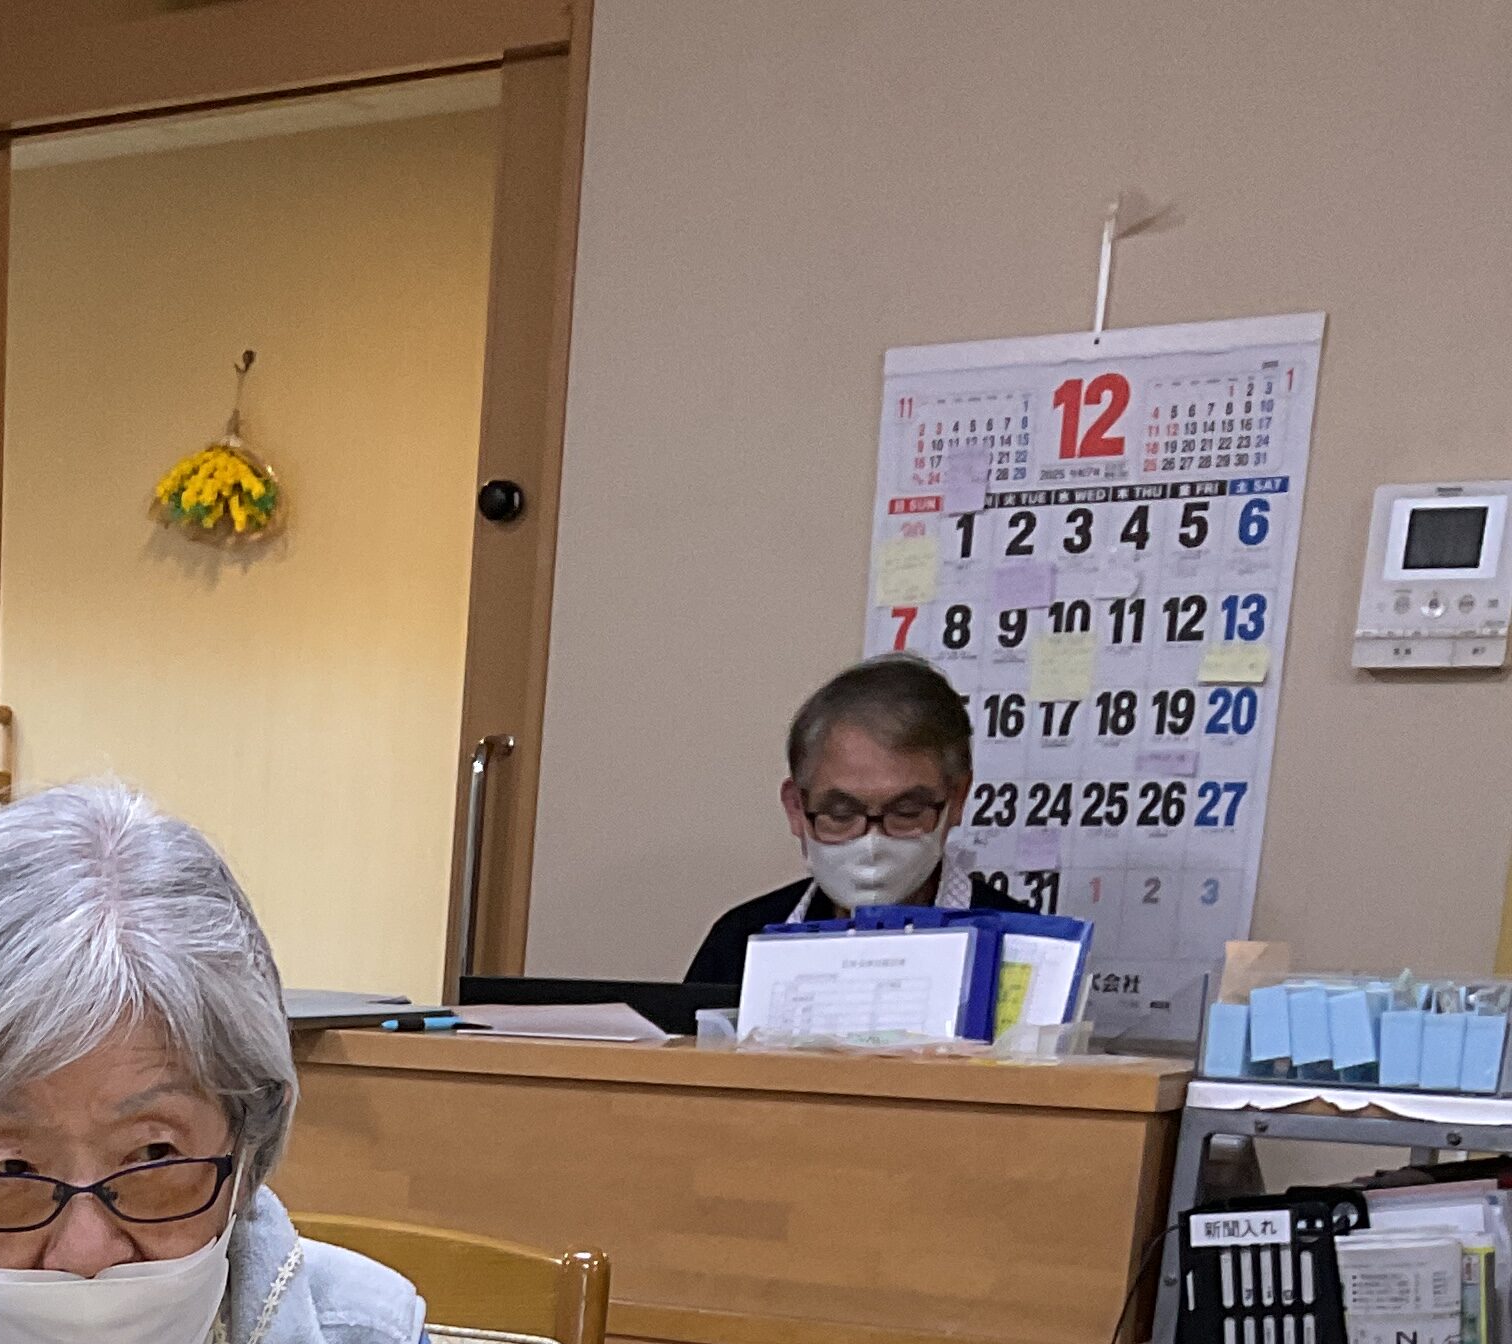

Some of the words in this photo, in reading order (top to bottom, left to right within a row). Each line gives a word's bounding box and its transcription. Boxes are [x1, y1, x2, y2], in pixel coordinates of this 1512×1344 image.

[1246, 383, 1254, 396] 2
[900, 398, 912, 418] 11
[1053, 373, 1130, 460] 12
[1152, 407, 1159, 419] 4
[1171, 405, 1177, 419] 5
[1189, 404, 1196, 417] 6
[1208, 403, 1215, 415] 7
[1226, 402, 1233, 415] 8
[1245, 401, 1252, 414] 9
[1261, 400, 1273, 412] 10
[953, 421, 959, 433] 4
[1004, 417, 1011, 430] 7
[1148, 425, 1159, 437] 11
[1167, 424, 1179, 436] 12
[1184, 422, 1197, 435] 13
[1203, 421, 1215, 433] 14
[1222, 420, 1234, 432] 15
[1240, 418, 1252, 431] 16
[1259, 417, 1272, 430] 17
[1145, 442, 1159, 454] 18
[1164, 441, 1177, 453] 19
[1182, 440, 1195, 452] 20
[1201, 439, 1213, 451] 21
[1218, 437, 1232, 450] 22
[1237, 436, 1251, 449] 23
[1255, 435, 1269, 448] 24
[1144, 459, 1157, 472] 25
[1161, 458, 1175, 470] 26
[1179, 457, 1193, 470] 27
[1198, 456, 1212, 469] 28
[1216, 455, 1230, 468] 29
[1234, 453, 1248, 466] 30
[1254, 452, 1266, 466] 31
[1075, 489, 1106, 502] WED
[1134, 485, 1163, 498] THU
[1196, 482, 1220, 495] FRI
[1253, 478, 1283, 492] SAT
[956, 513, 976, 558] 1
[1005, 511, 1037, 556] 2
[1063, 508, 1094, 554] 3
[1120, 505, 1149, 550] 4
[1178, 501, 1210, 549] 5
[1238, 498, 1270, 546] 6
[891, 606, 918, 652] 7
[942, 604, 972, 650] 8
[998, 608, 1028, 648] 9
[1048, 599, 1091, 632] 10
[1109, 598, 1146, 644] 11
[1162, 594, 1208, 642] 12
[1221, 593, 1268, 641] 13
[984, 693, 1026, 738] 16
[1039, 700, 1082, 737] 17
[1096, 690, 1137, 736] 18
[1152, 689, 1196, 735] 19
[1205, 687, 1258, 735] 20
[971, 782, 1019, 827] 23
[1025, 782, 1073, 827] 24
[1080, 781, 1130, 827] 25
[1136, 781, 1187, 827] 26
[1194, 781, 1248, 827] 27
[1090, 877, 1102, 904] 1
[1142, 877, 1161, 904] 2
[1201, 878, 1220, 905] 3
[1204, 1219, 1278, 1240] 新聞入れ
